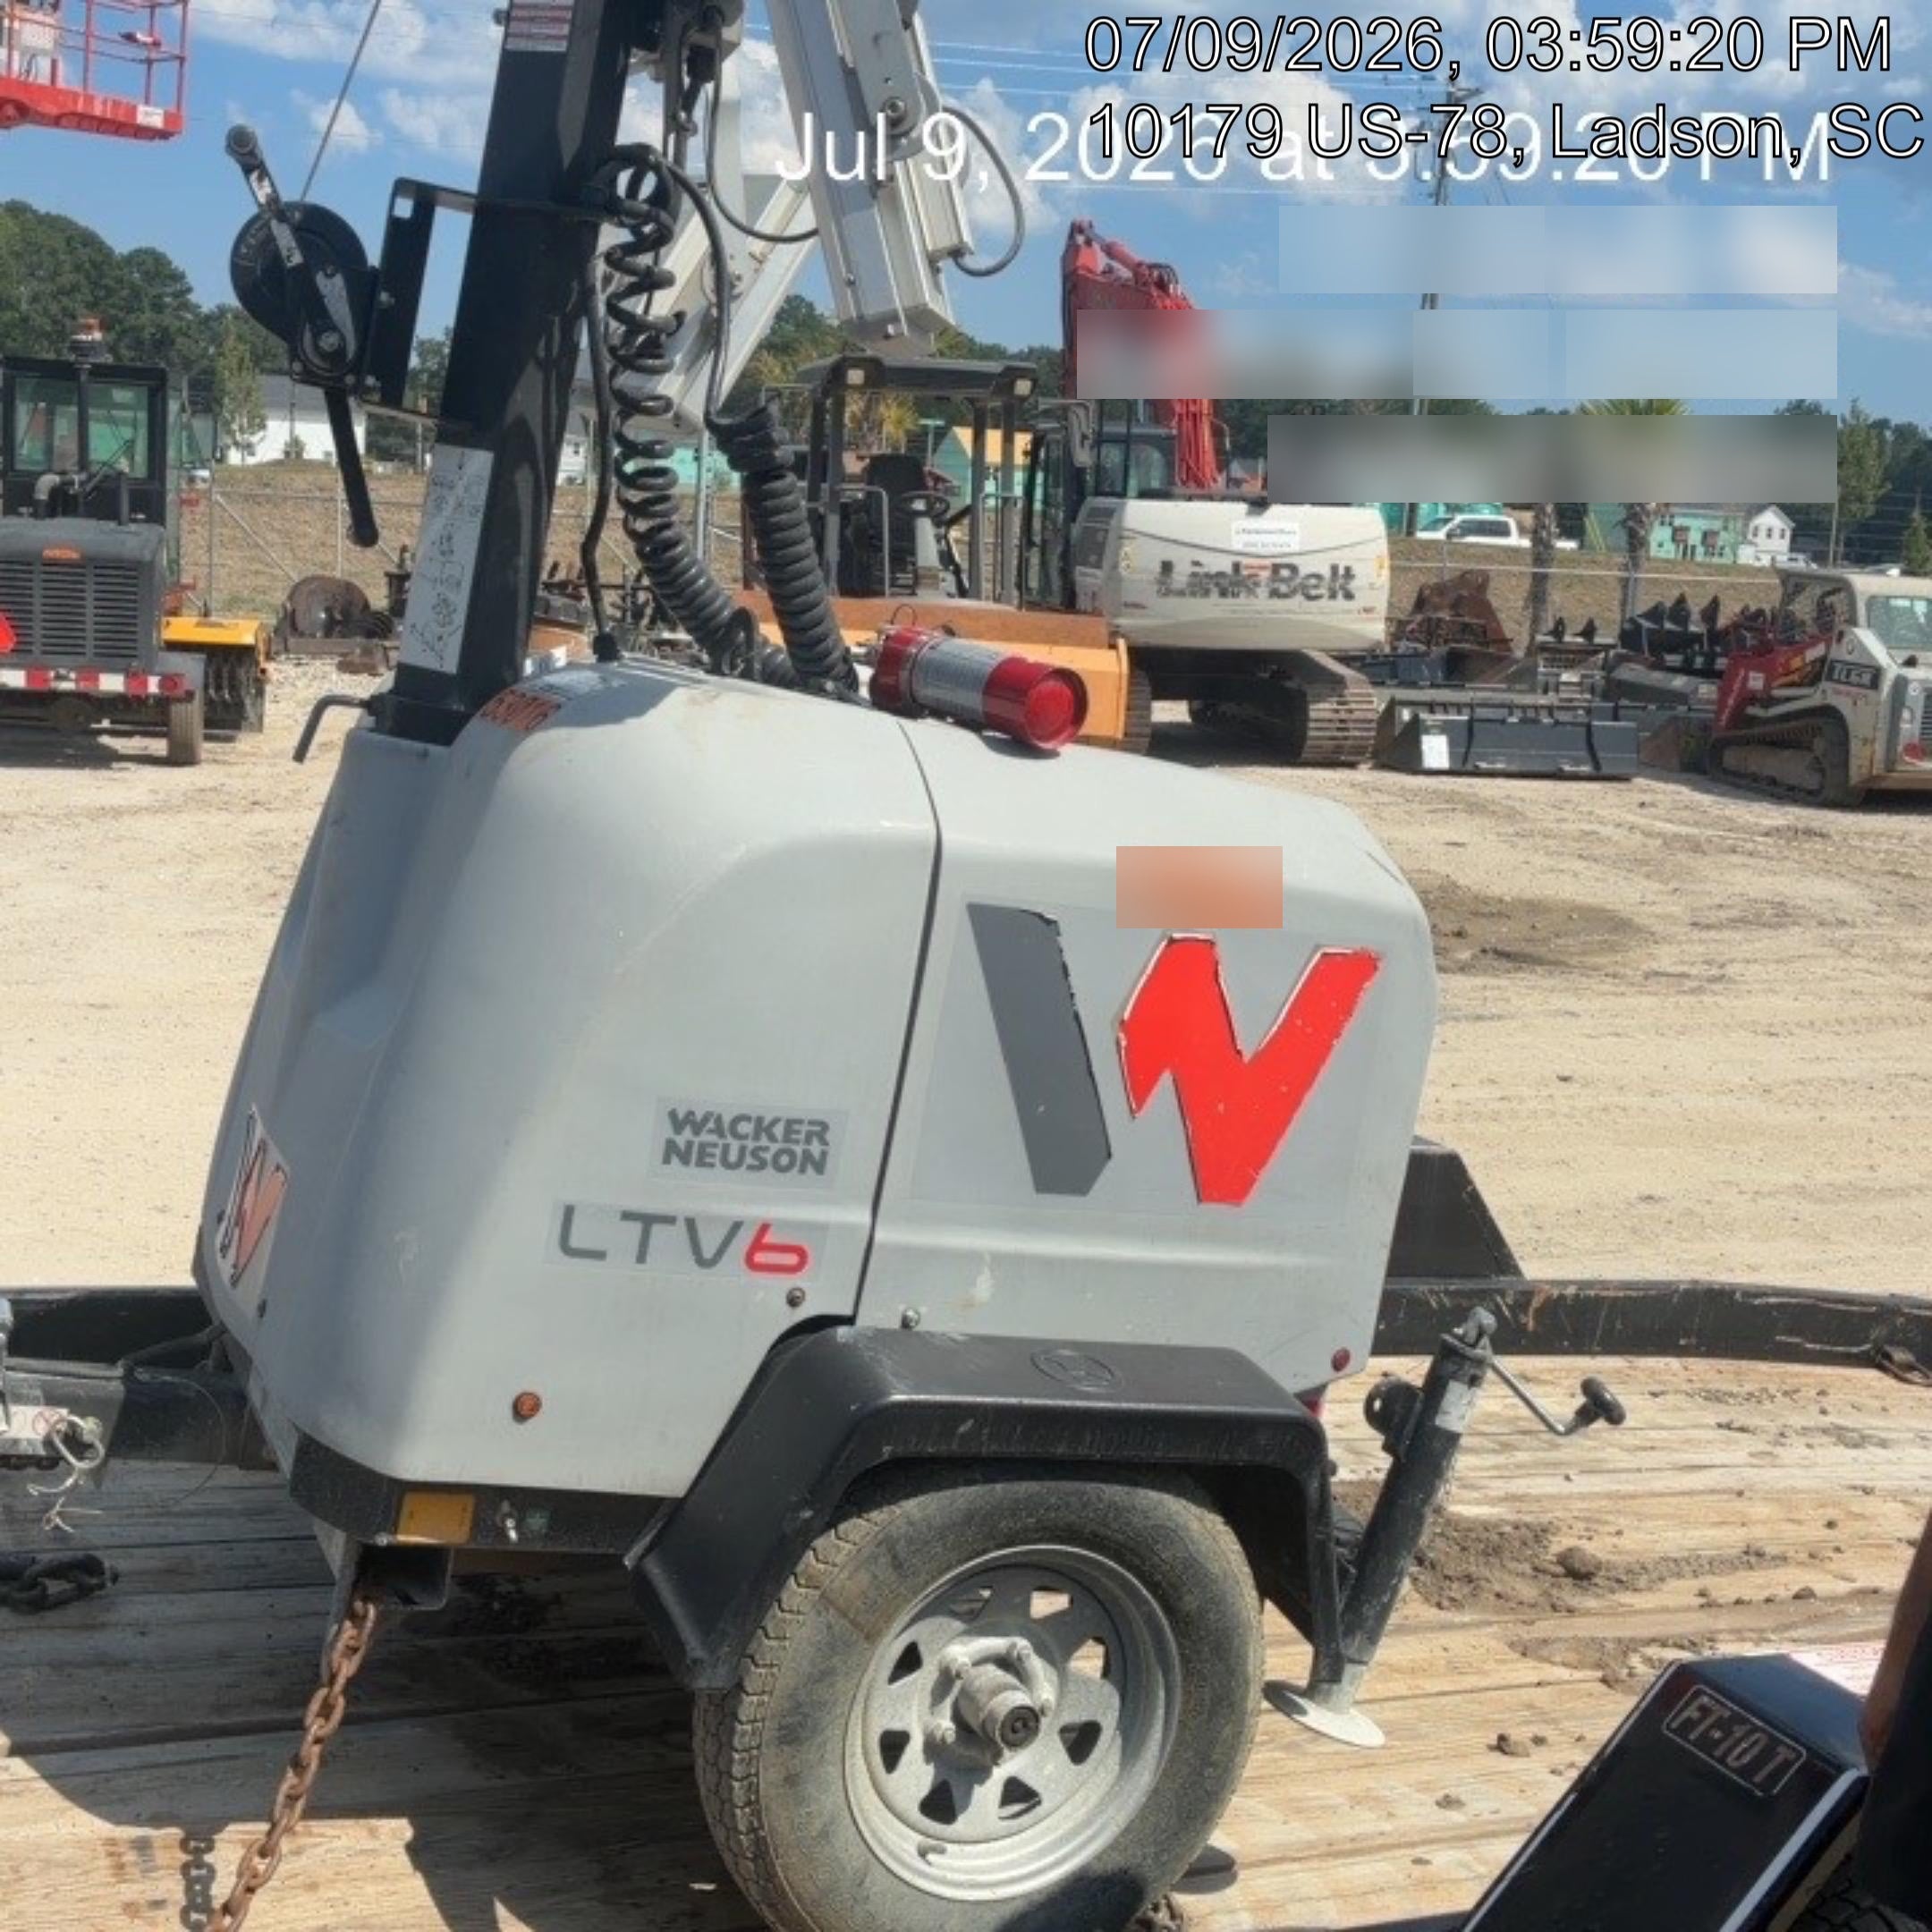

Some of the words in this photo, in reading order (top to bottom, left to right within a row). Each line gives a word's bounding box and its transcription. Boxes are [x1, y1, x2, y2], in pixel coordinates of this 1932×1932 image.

[668, 1107, 830, 1146] WACKER
[662, 1138, 827, 1175] NEUSON
[559, 1204, 809, 1275] LTV6
